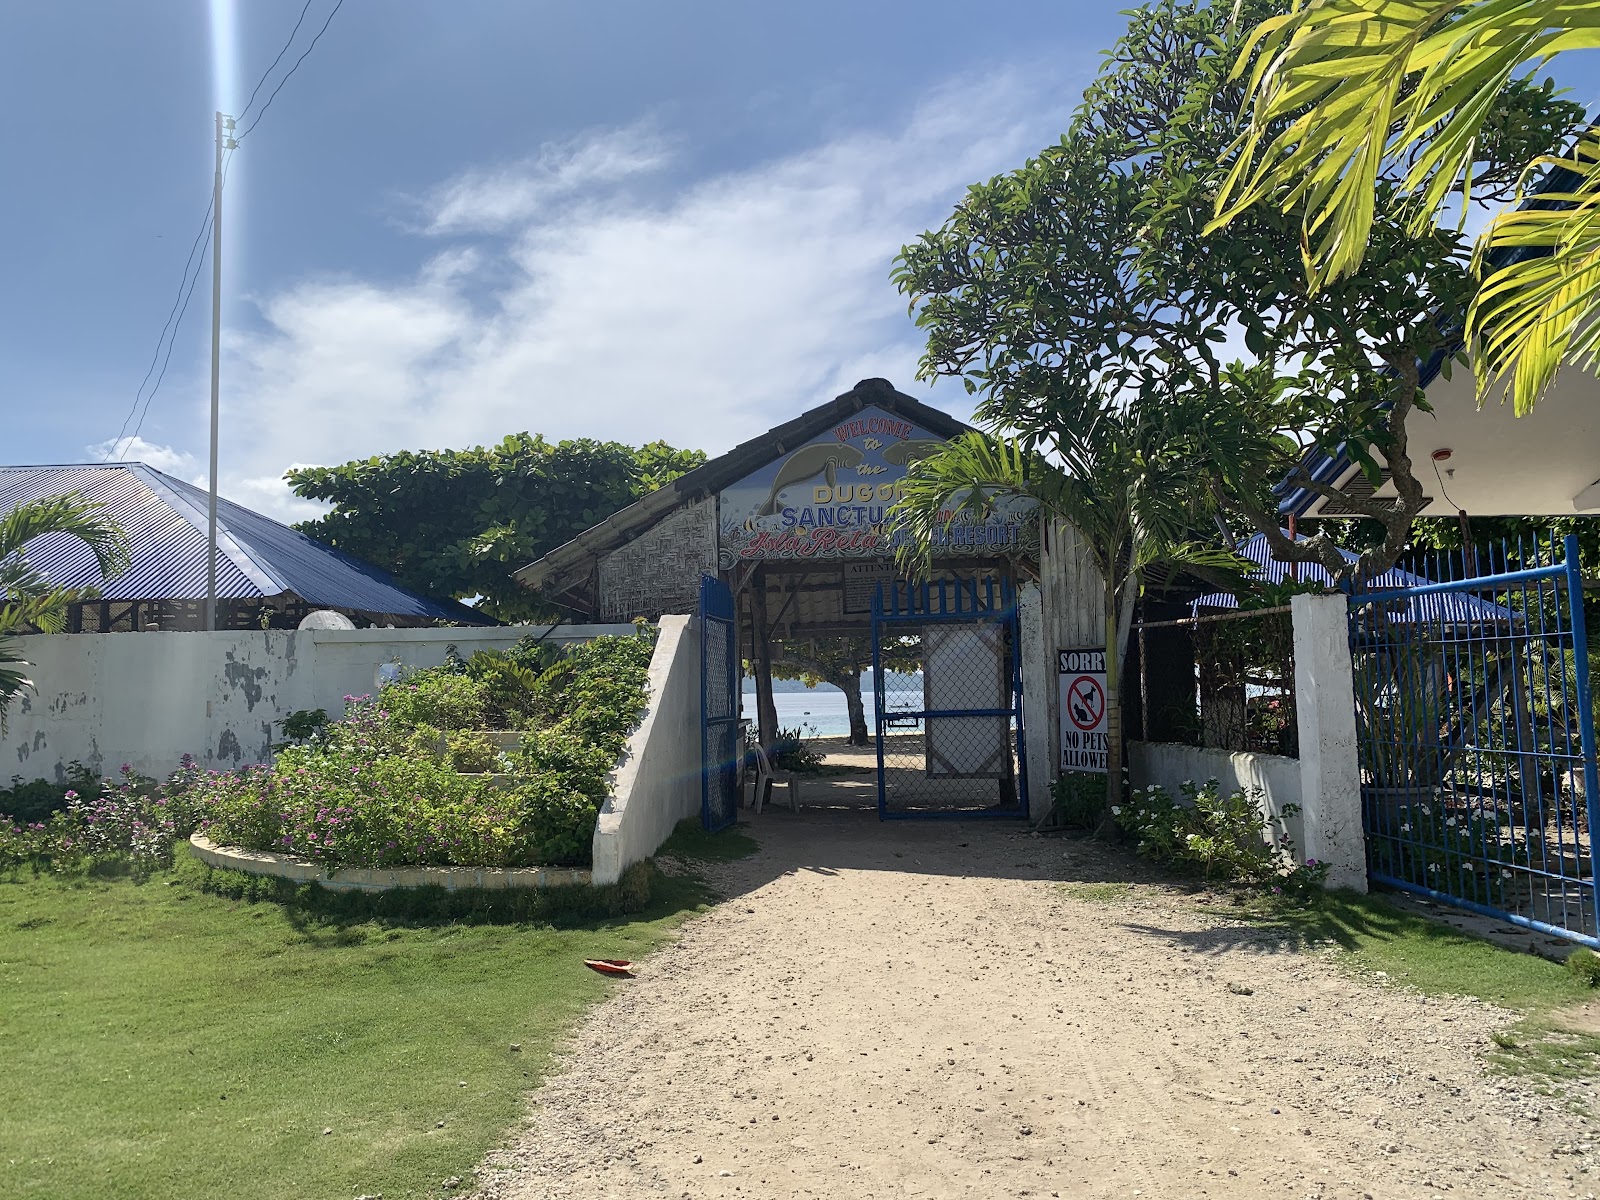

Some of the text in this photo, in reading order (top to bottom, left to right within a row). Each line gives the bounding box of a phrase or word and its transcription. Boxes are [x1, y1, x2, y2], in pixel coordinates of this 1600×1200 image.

[832, 417, 913, 442] WELCOME
[863, 437, 884, 450] to
[856, 463, 888, 475] the
[953, 524, 1019, 546] RESORT
[1065, 730, 1109, 751] NO PETS
